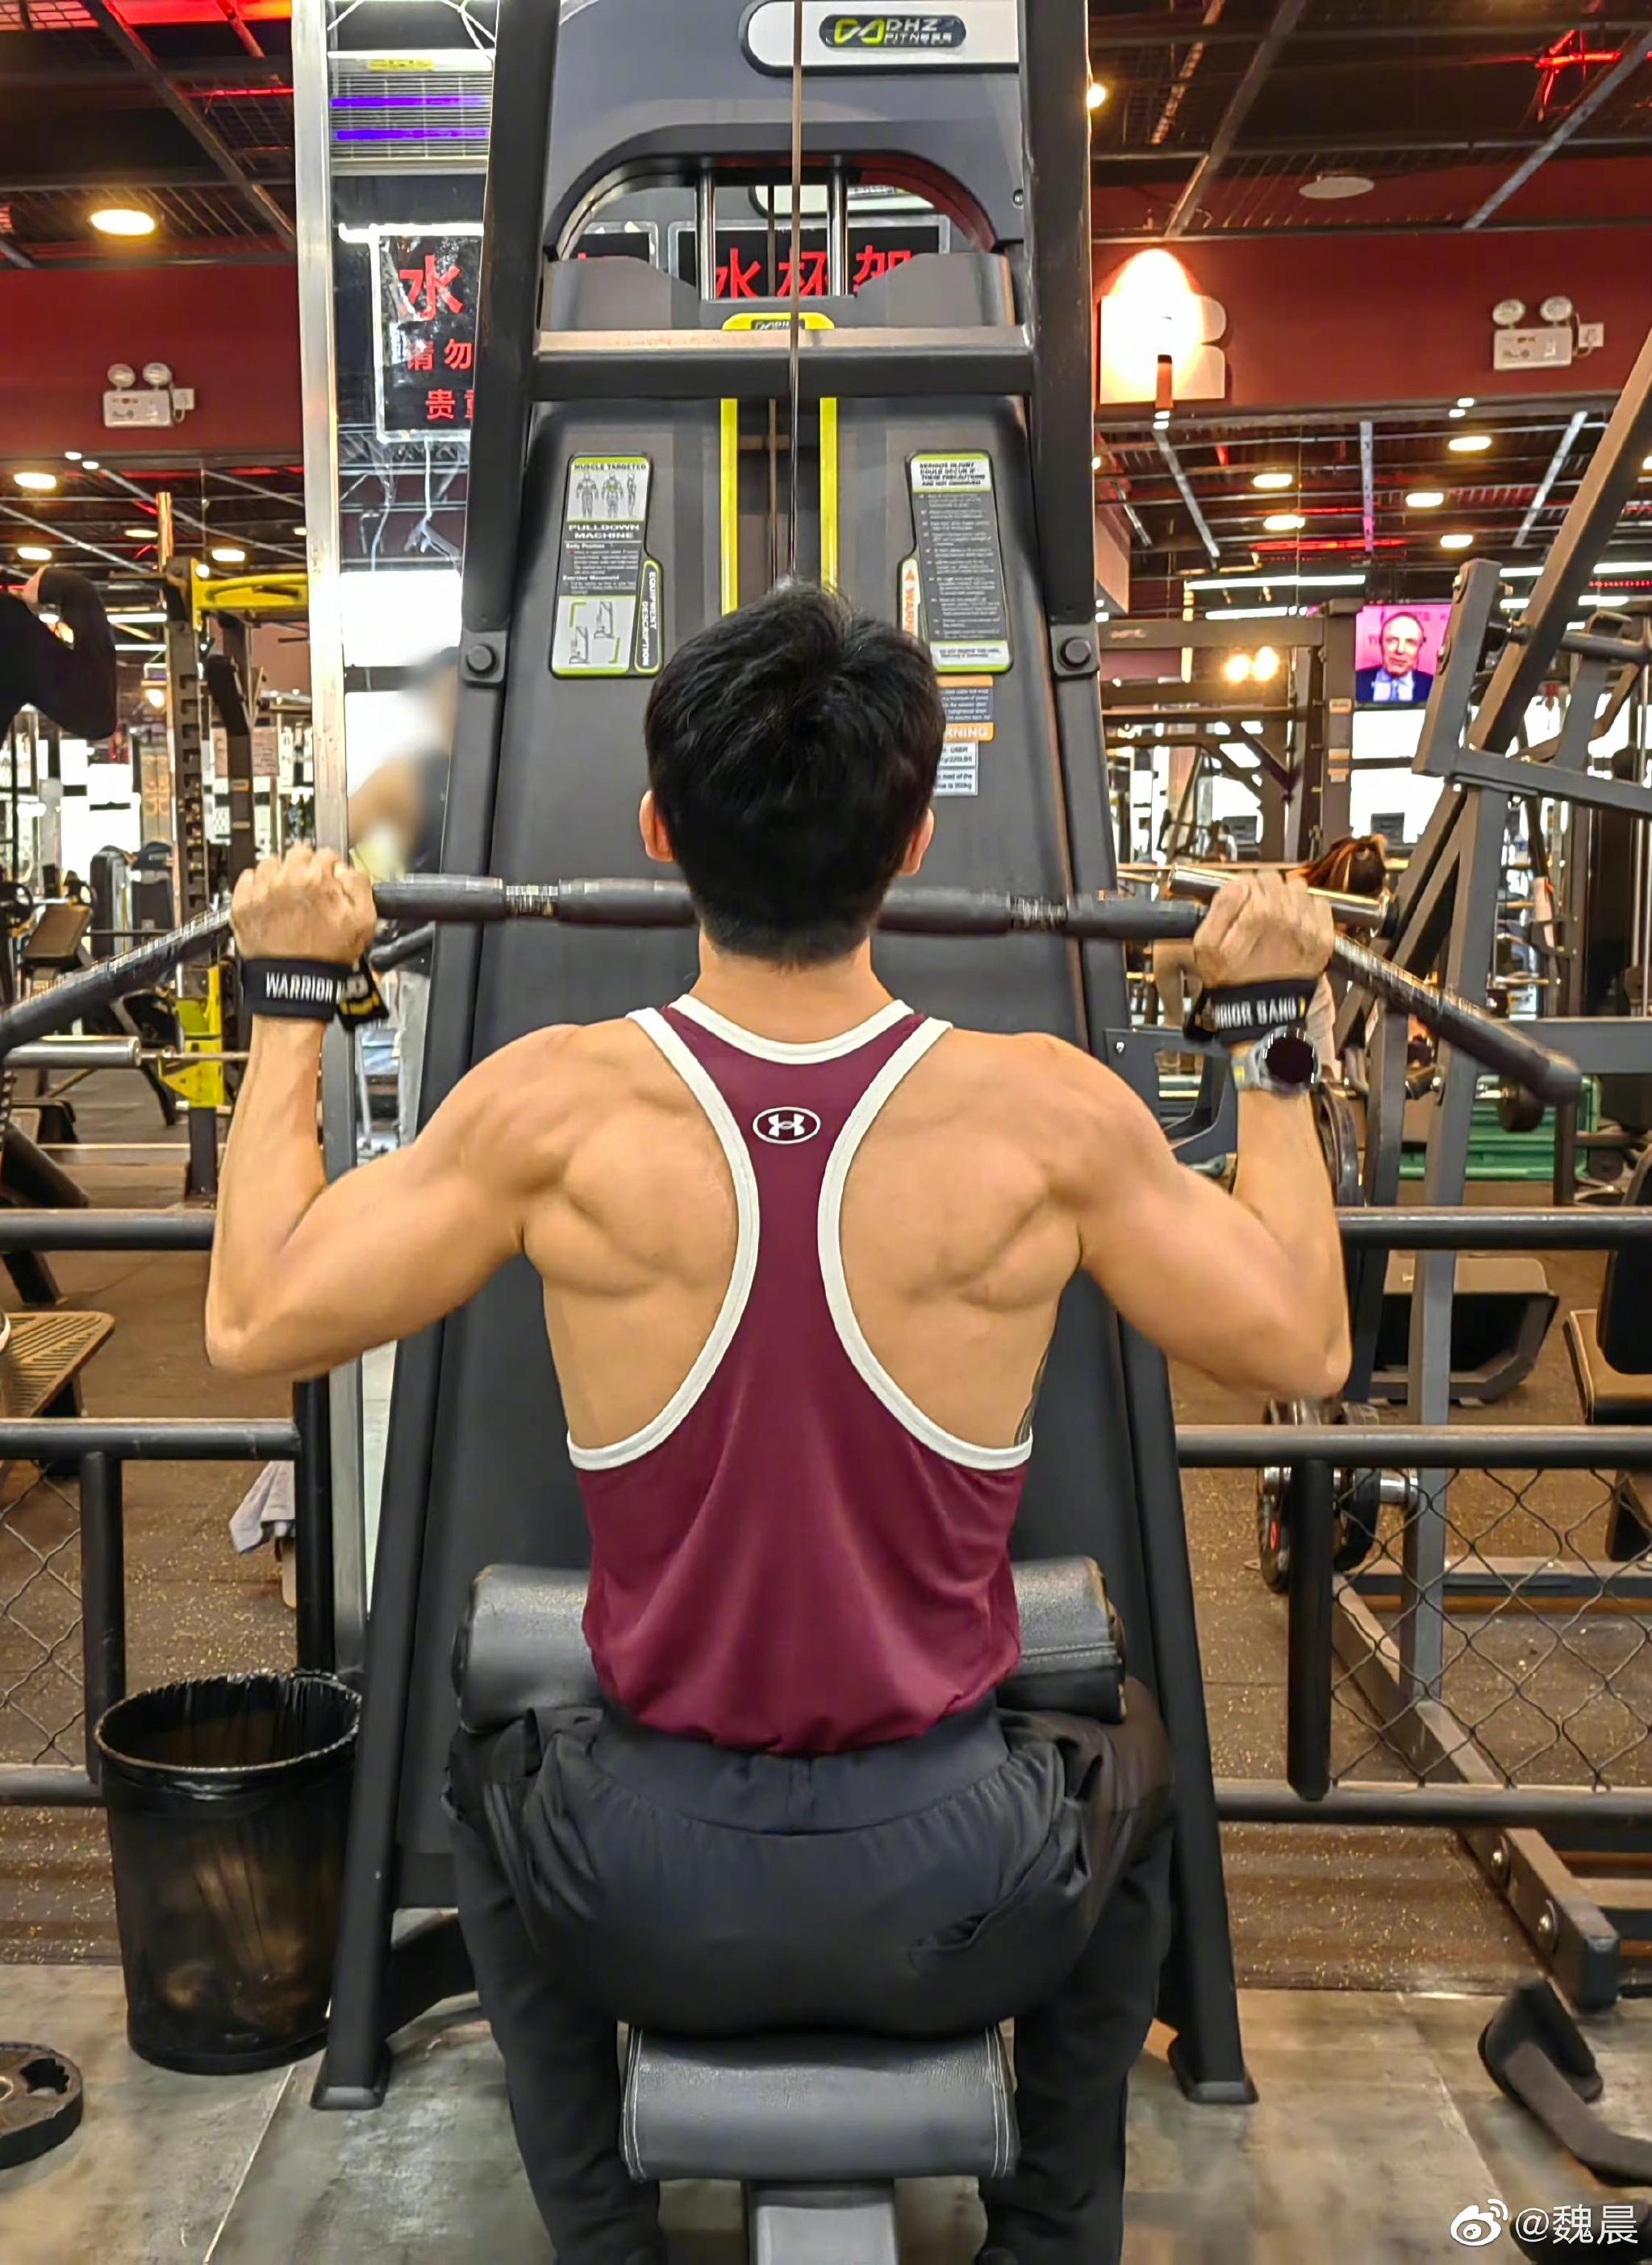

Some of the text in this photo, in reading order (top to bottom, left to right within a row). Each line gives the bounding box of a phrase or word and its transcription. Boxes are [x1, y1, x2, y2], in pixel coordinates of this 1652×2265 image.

[886, 18, 939, 31] DHZ
[398, 254, 465, 321] 水
[574, 532, 634, 540] MACHINE
[946, 728, 988, 738] RNING
[265, 971, 334, 1003] WARRIOR
